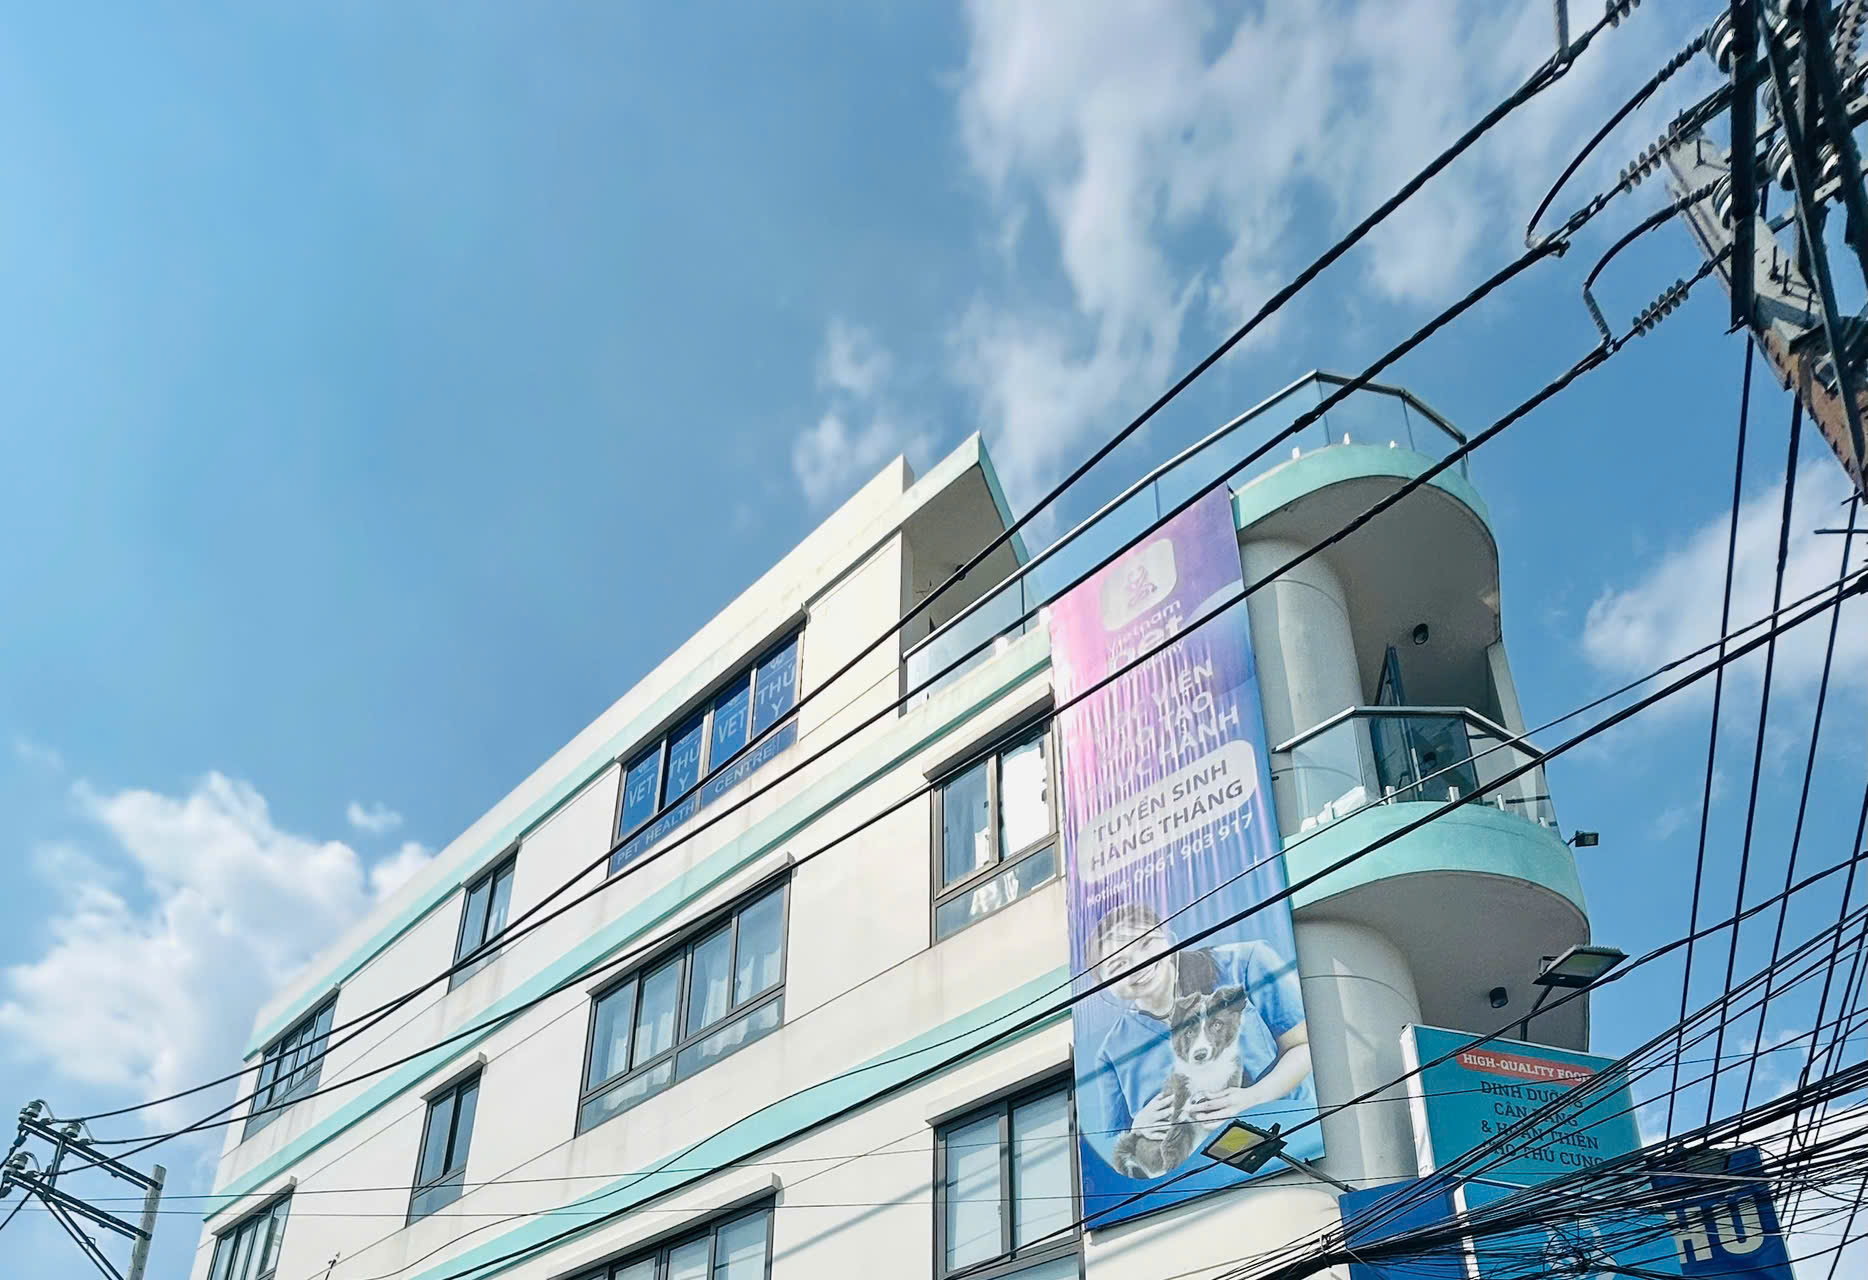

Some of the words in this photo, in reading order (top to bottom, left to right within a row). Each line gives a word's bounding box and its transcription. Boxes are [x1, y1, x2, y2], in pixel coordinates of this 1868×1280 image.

[717, 706, 747, 744] VET
[628, 773, 656, 808] VET
[1171, 759, 1228, 802] SINH
[616, 842, 642, 865] PET
[645, 801, 696, 845] HEALTH
[714, 745, 774, 793] CENTRE
[1091, 826, 1155, 871] HÀNG
[1158, 778, 1244, 834] THÁNG
[1180, 834, 1214, 860] 903
[1218, 811, 1253, 841] 917
[1463, 1053, 1555, 1078] HIGH-QUALITY
[1480, 1081, 1522, 1099] DINH
[1494, 1101, 1527, 1119] CÂN
